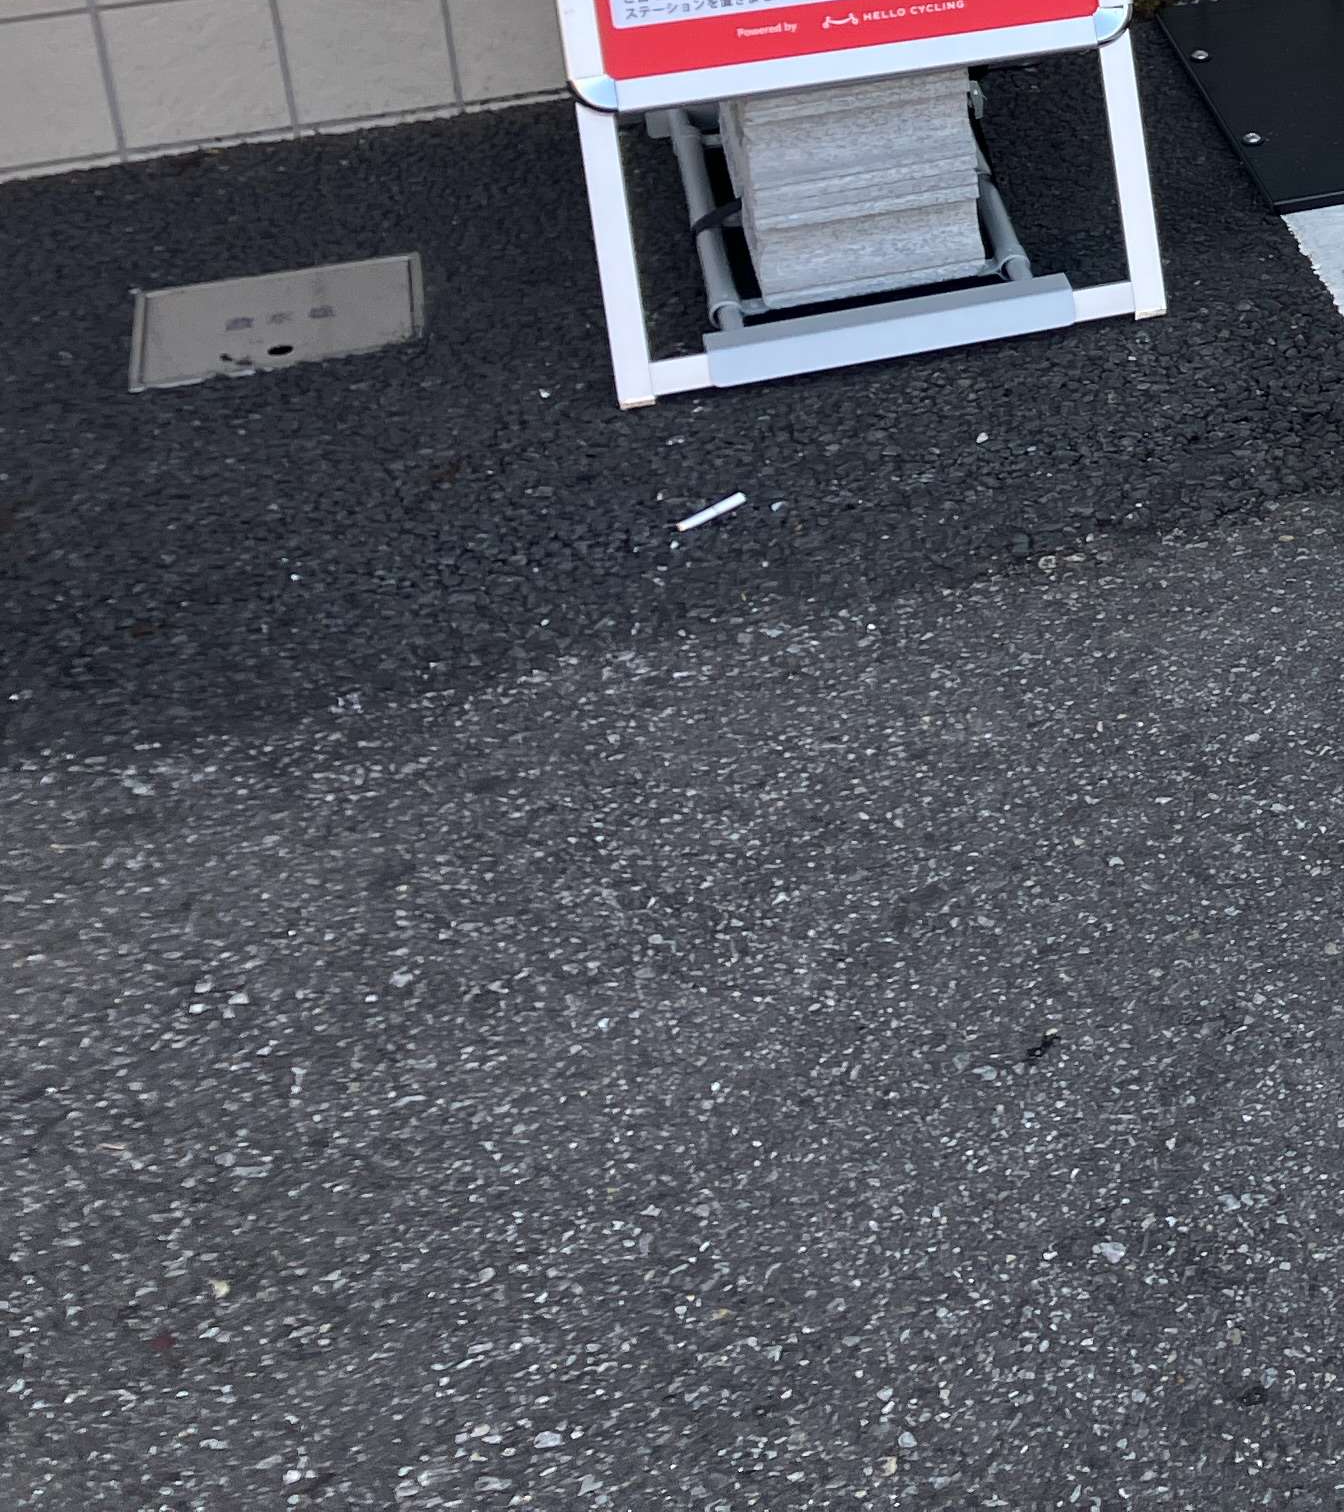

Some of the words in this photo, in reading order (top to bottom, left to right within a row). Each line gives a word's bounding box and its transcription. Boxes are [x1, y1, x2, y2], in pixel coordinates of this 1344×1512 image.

[863, 7, 906, 21] HELLO
[909, 0, 965, 15] CYCLING
[736, 23, 782, 38] Powered
[783, 22, 797, 34] by
